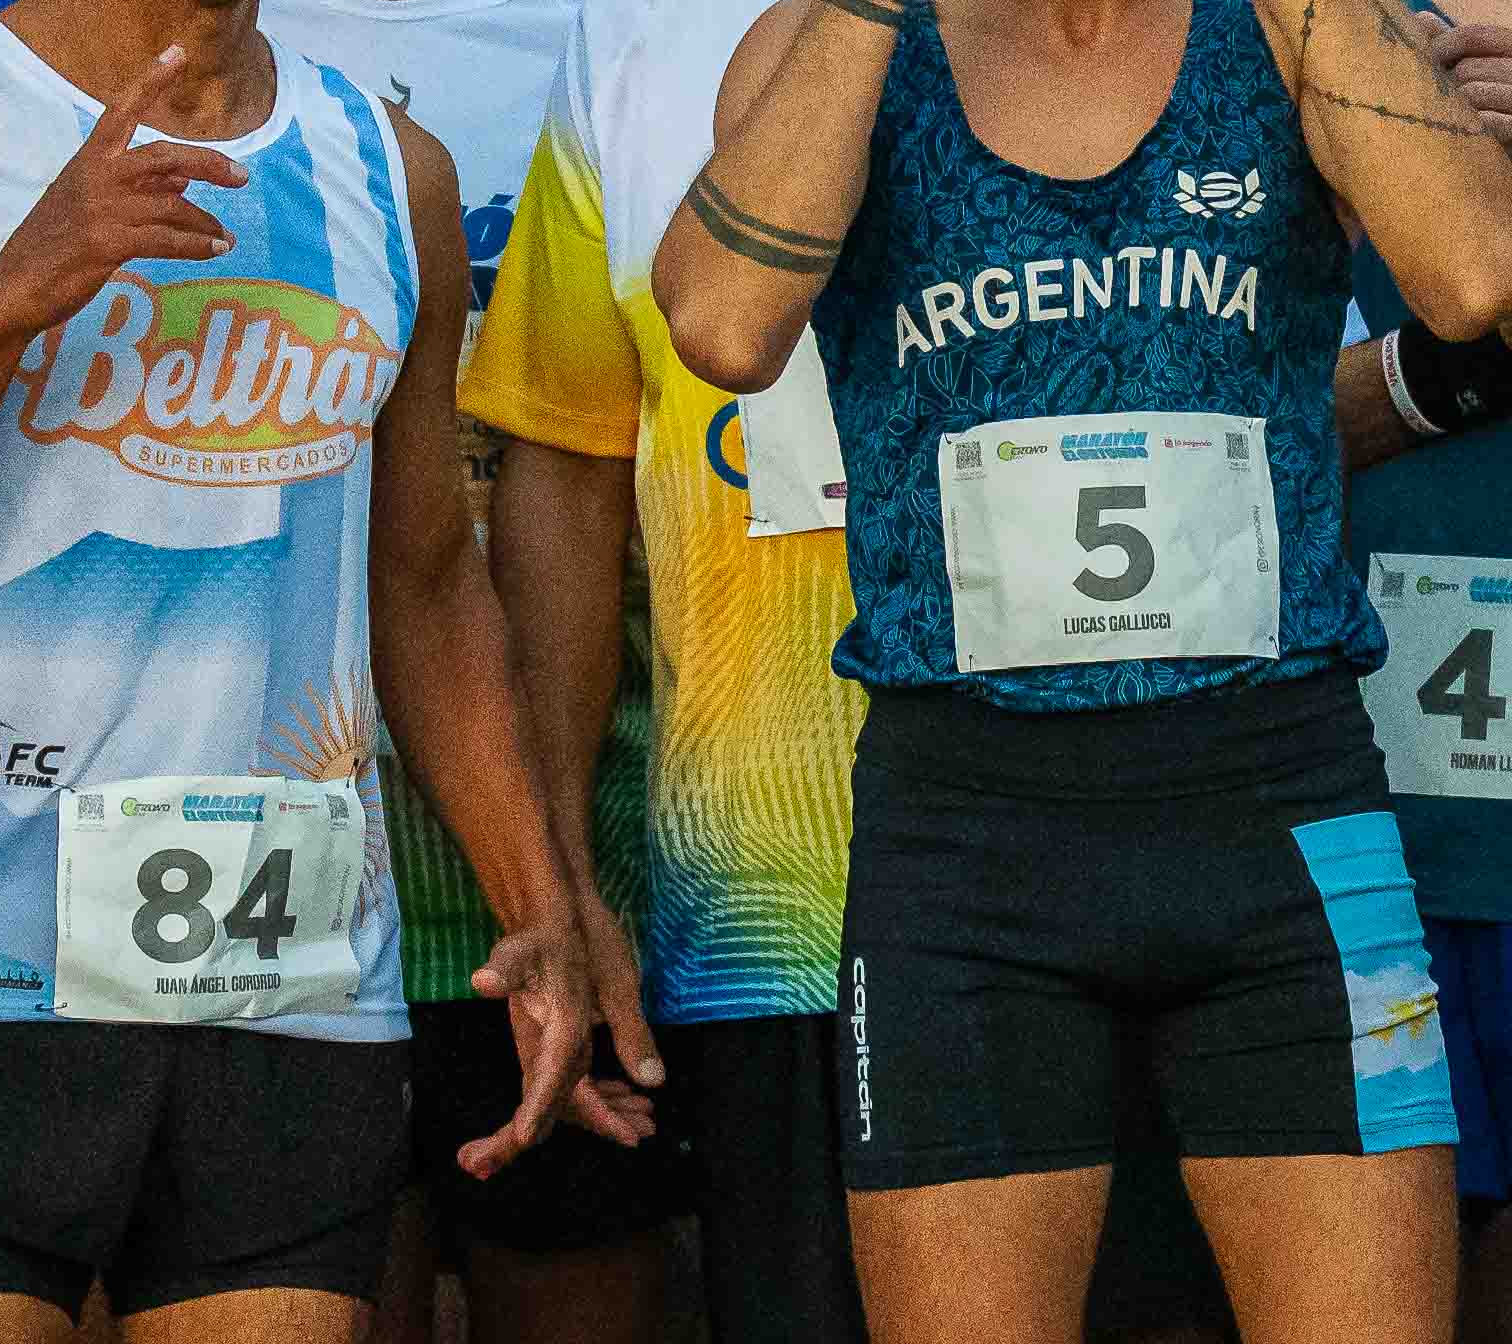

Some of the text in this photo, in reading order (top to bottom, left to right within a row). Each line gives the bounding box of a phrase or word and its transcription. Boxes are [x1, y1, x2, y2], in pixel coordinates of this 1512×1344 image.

[896, 246, 1258, 368] ARGENTINA
[136, 440, 348, 475] SUPERMERCADOS
[1072, 485, 1156, 602] 5
[1063, 612, 1172, 635] LUCAS GALLUCCI
[5, 742, 66, 775] FC
[131, 847, 297, 964] 84
[154, 976, 188, 995] JUAN
[190, 972, 229, 995] ÁNGEL
